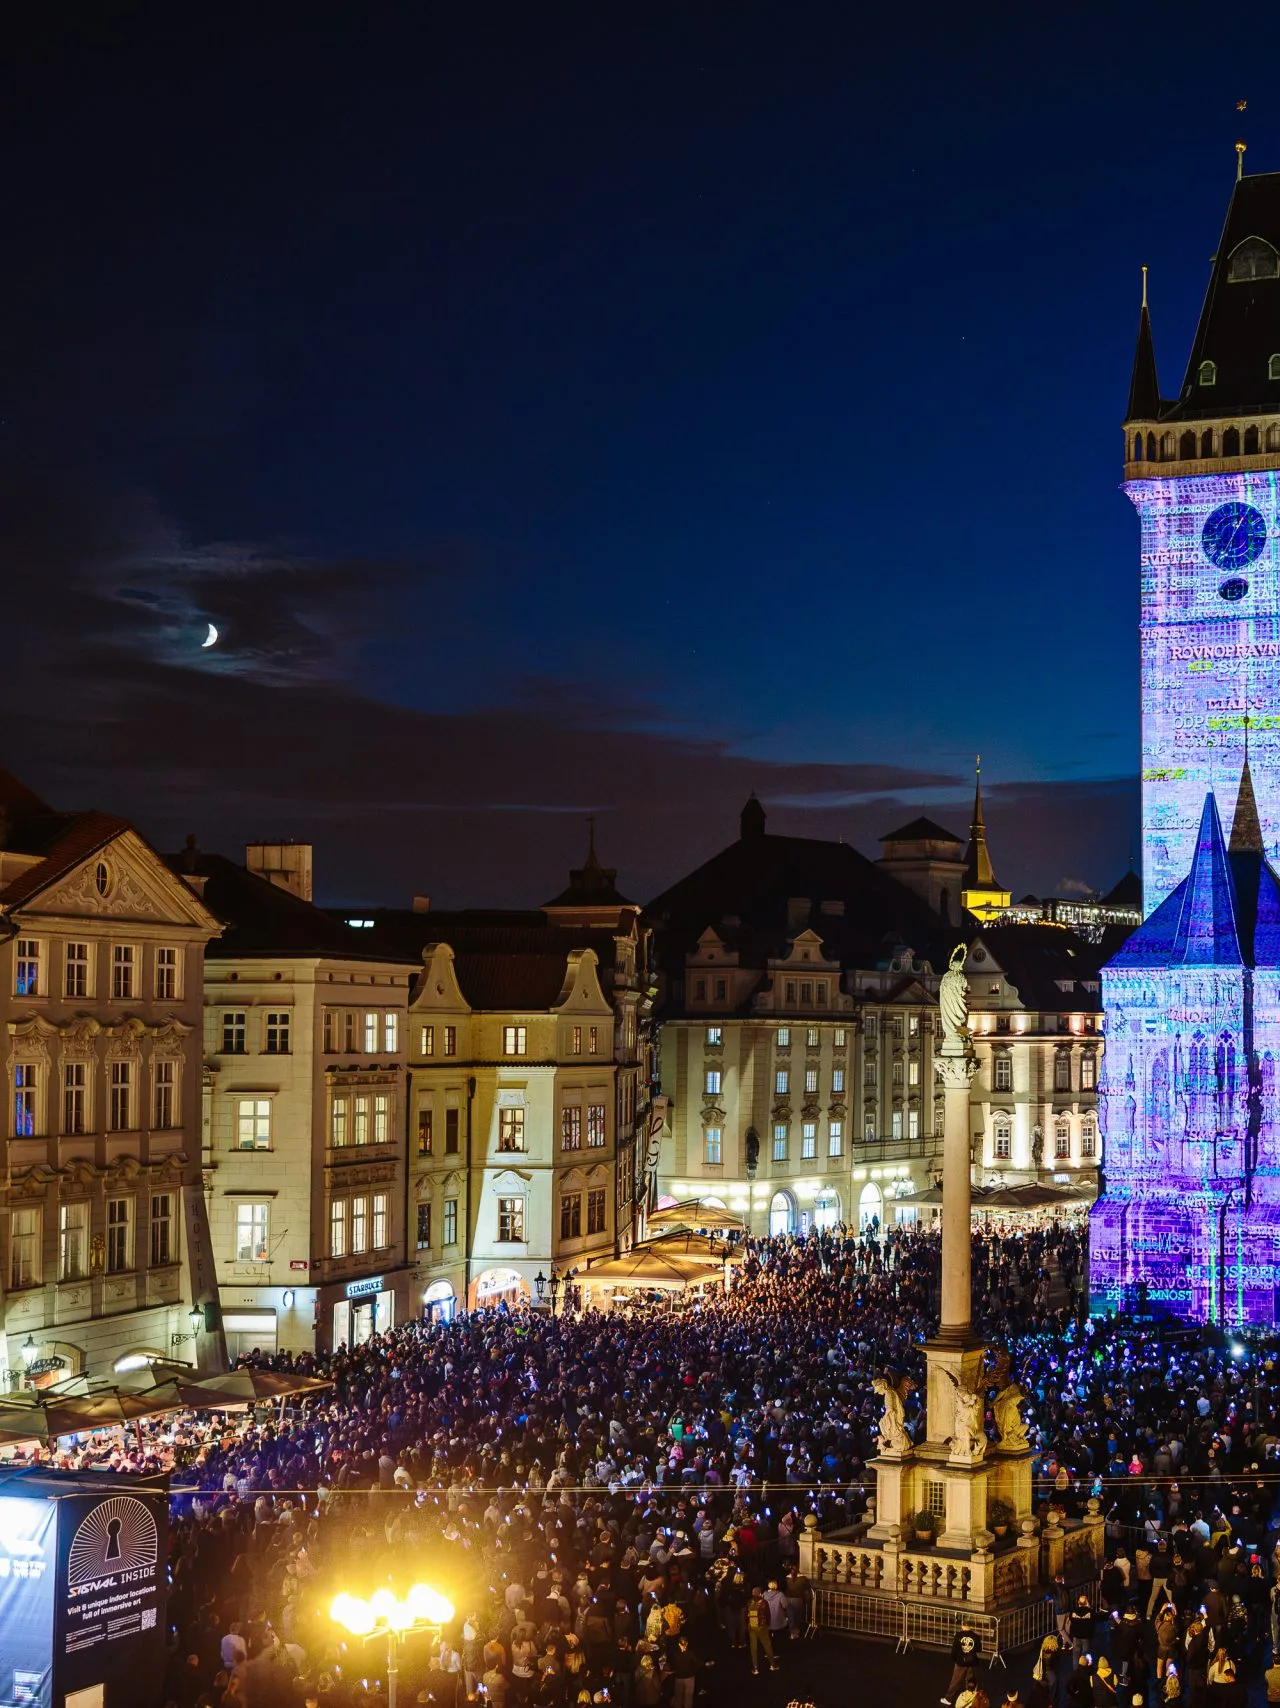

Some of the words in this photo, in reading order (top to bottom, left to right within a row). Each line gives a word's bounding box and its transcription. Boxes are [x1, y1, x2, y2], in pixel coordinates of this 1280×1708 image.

[348, 1279, 384, 1295] STARBUCKS
[67, 1576, 118, 1598] SIGNAL
[120, 1565, 156, 1584] INSIDE
[67, 1605, 81, 1615] Visit
[87, 1598, 108, 1609] unique
[109, 1593, 129, 1604] indoor
[129, 1585, 156, 1597] locations
[82, 1612, 93, 1621] full
[93, 1609, 100, 1617] of
[100, 1601, 132, 1615] immersive
[132, 1597, 142, 1606] art
